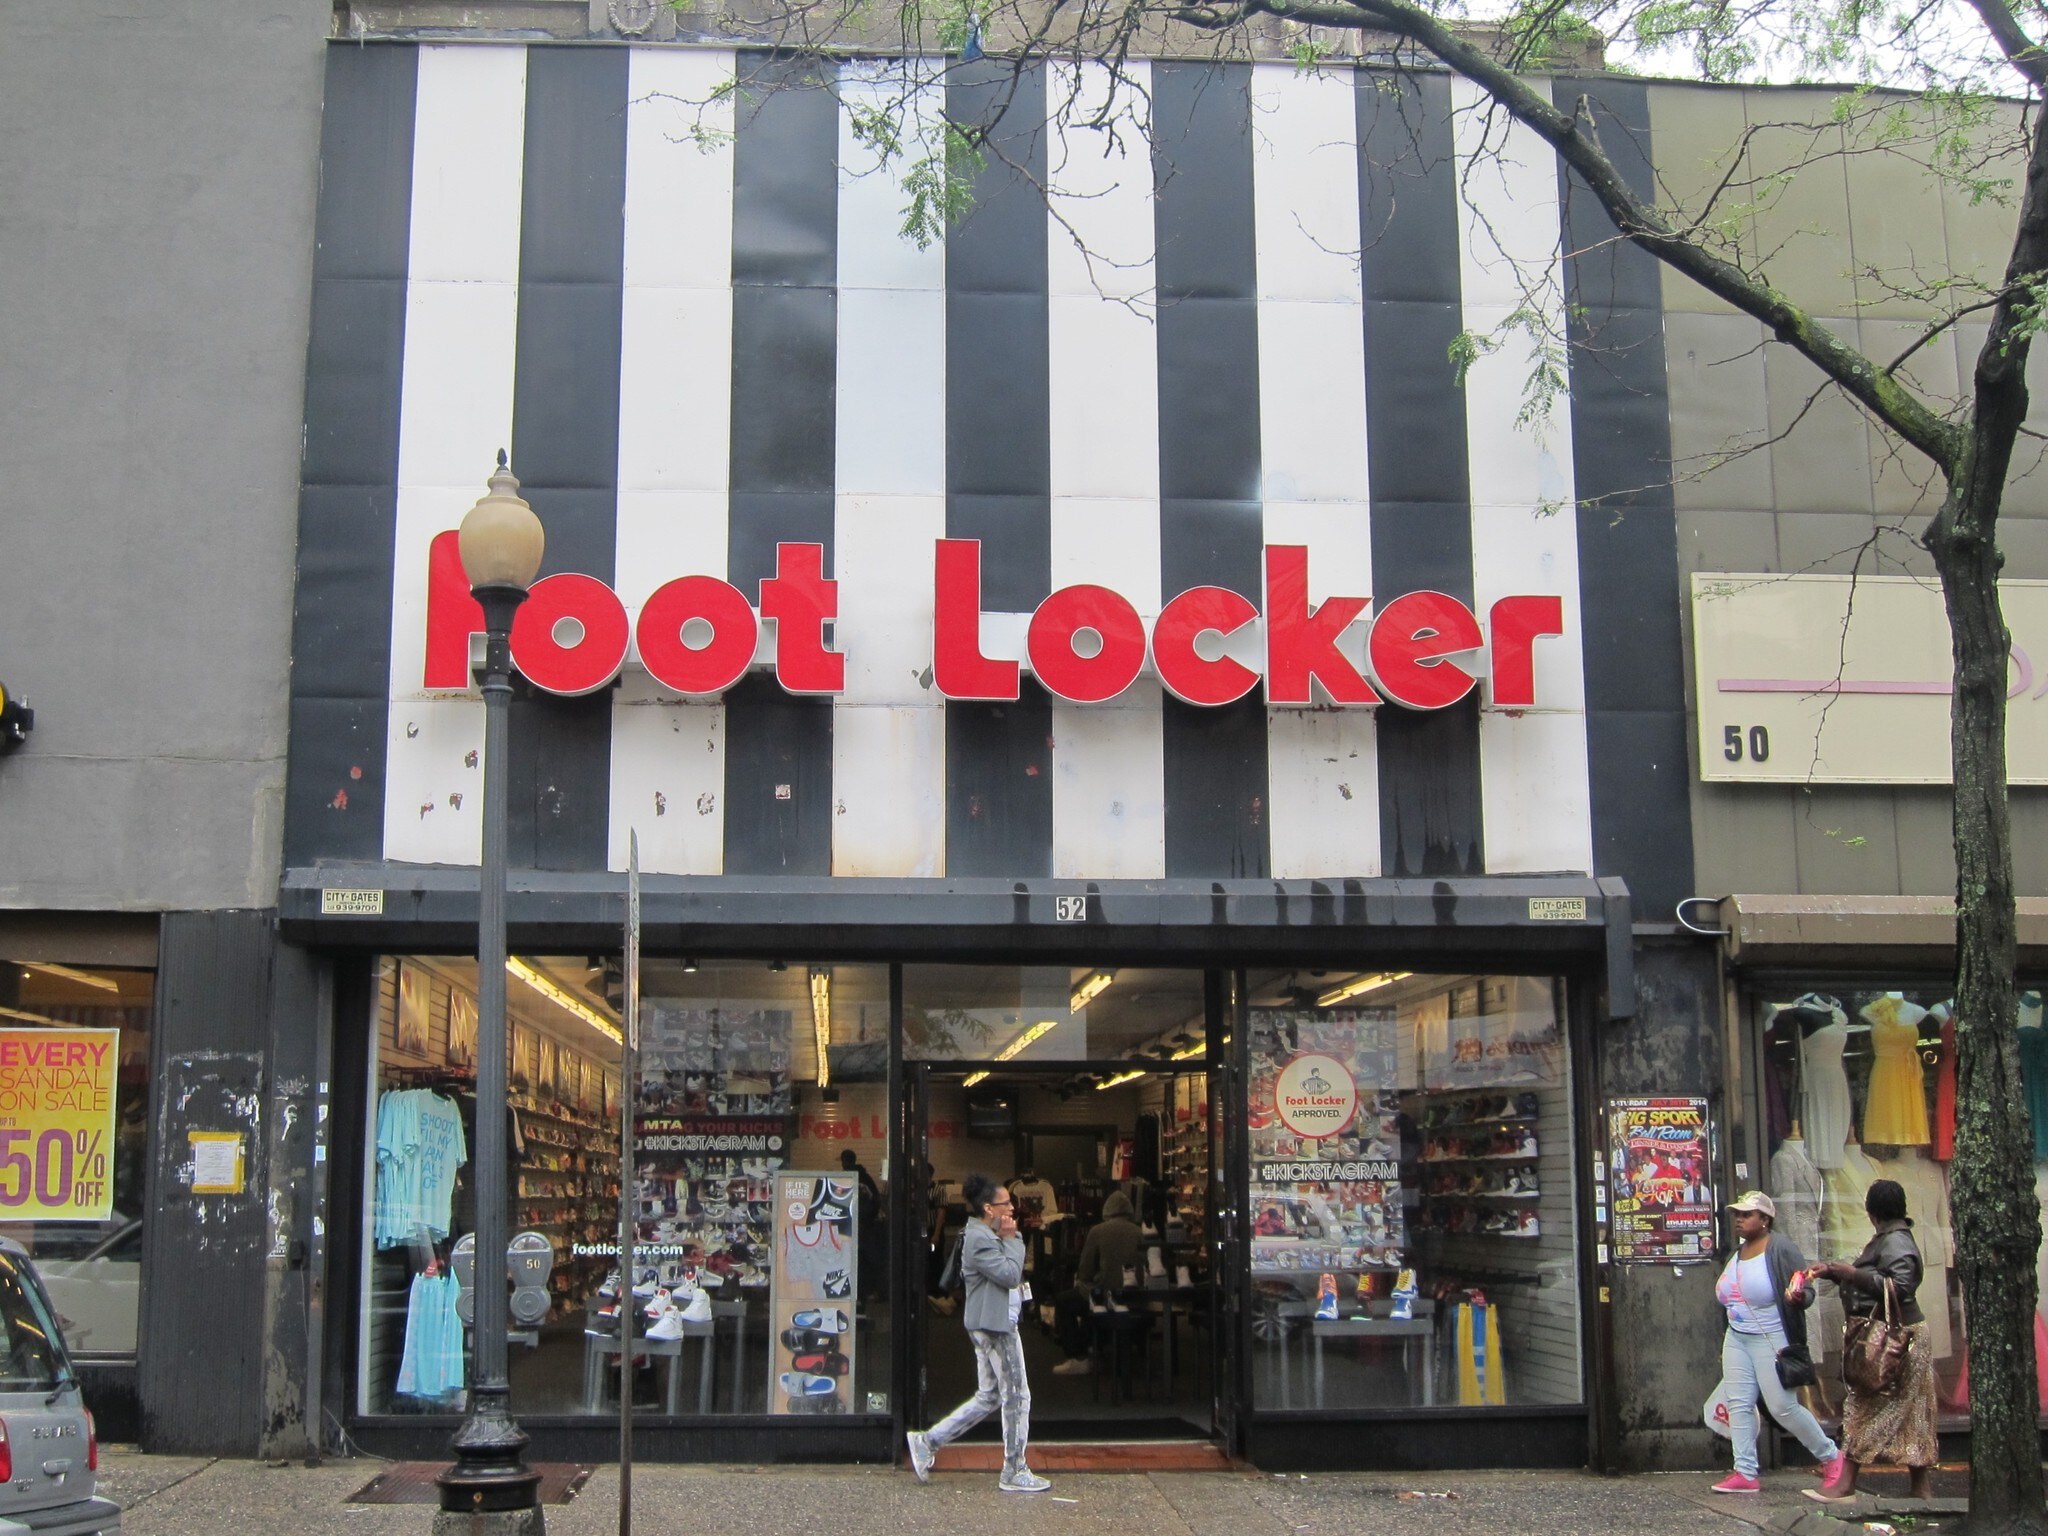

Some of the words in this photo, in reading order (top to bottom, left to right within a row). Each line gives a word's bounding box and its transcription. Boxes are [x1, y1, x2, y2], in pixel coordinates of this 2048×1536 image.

[423, 529, 845, 696] Foot
[932, 538, 1562, 710] Locker
[1724, 725, 1769, 762] 50
[1058, 897, 1084, 920] 52
[1, 1042, 109, 1066] EVERY
[0, 1068, 108, 1090] SANDAL
[0, 1091, 36, 1112] ON
[44, 1091, 107, 1112] SALE
[1286, 1097, 1308, 1105] Foot
[1311, 1096, 1346, 1105] Locker
[421, 1113, 454, 1133] SHOOT
[644, 1120, 683, 1130] MTA
[1649, 1111, 1701, 1125] SPORT
[645, 1136, 765, 1151] #KICKSTAGRAM
[1263, 1163, 1398, 1181] #KICKSTAGRAM
[74, 1181, 104, 1207] OFF
[573, 1243, 683, 1254] footlocer.com
[526, 1259, 540, 1269] 50
[825, 1269, 845, 1281] NIKE
